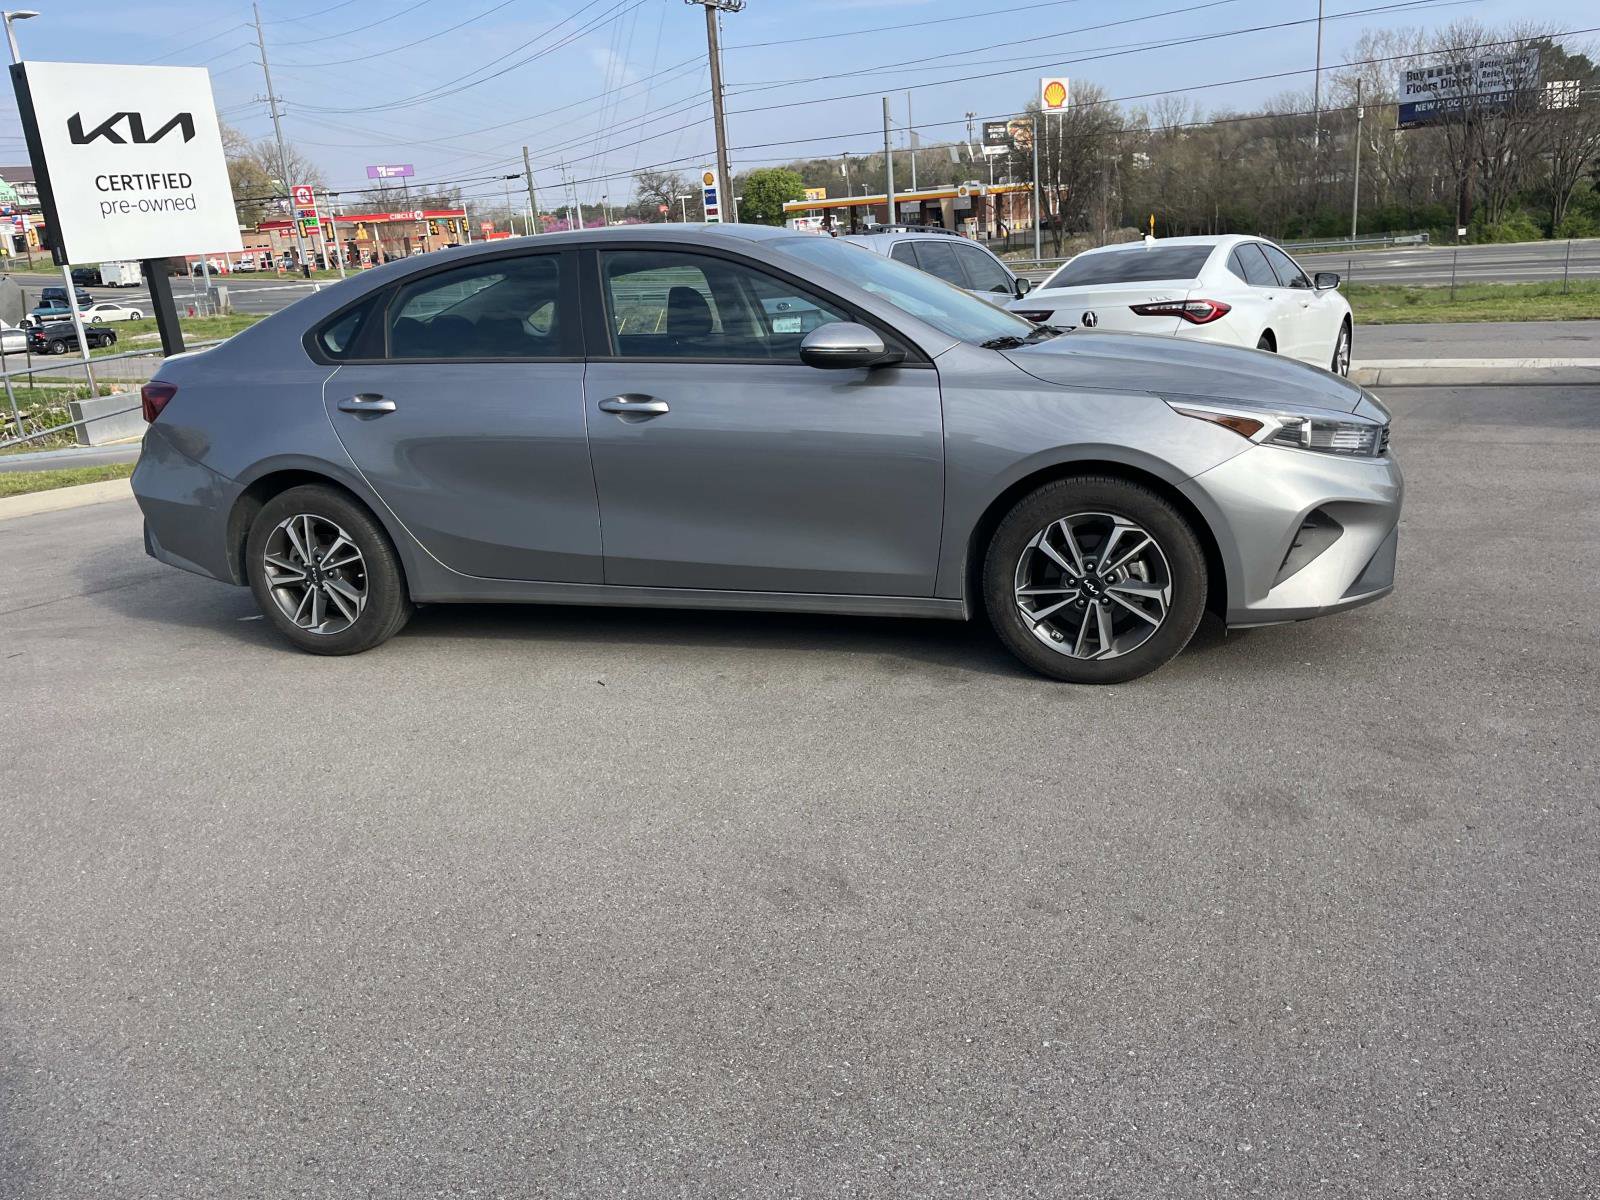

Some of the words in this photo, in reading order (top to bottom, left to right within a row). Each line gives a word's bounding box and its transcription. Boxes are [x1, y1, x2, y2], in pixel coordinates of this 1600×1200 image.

[1406, 70, 1425, 83] Buy
[1406, 82, 1438, 95] Floors
[1415, 101, 1435, 112] NEW
[67, 111, 196, 145] KIA
[95, 172, 192, 192] CERTIFIED
[99, 193, 197, 219] pre-owned
[389, 211, 415, 220] CIRCLE
